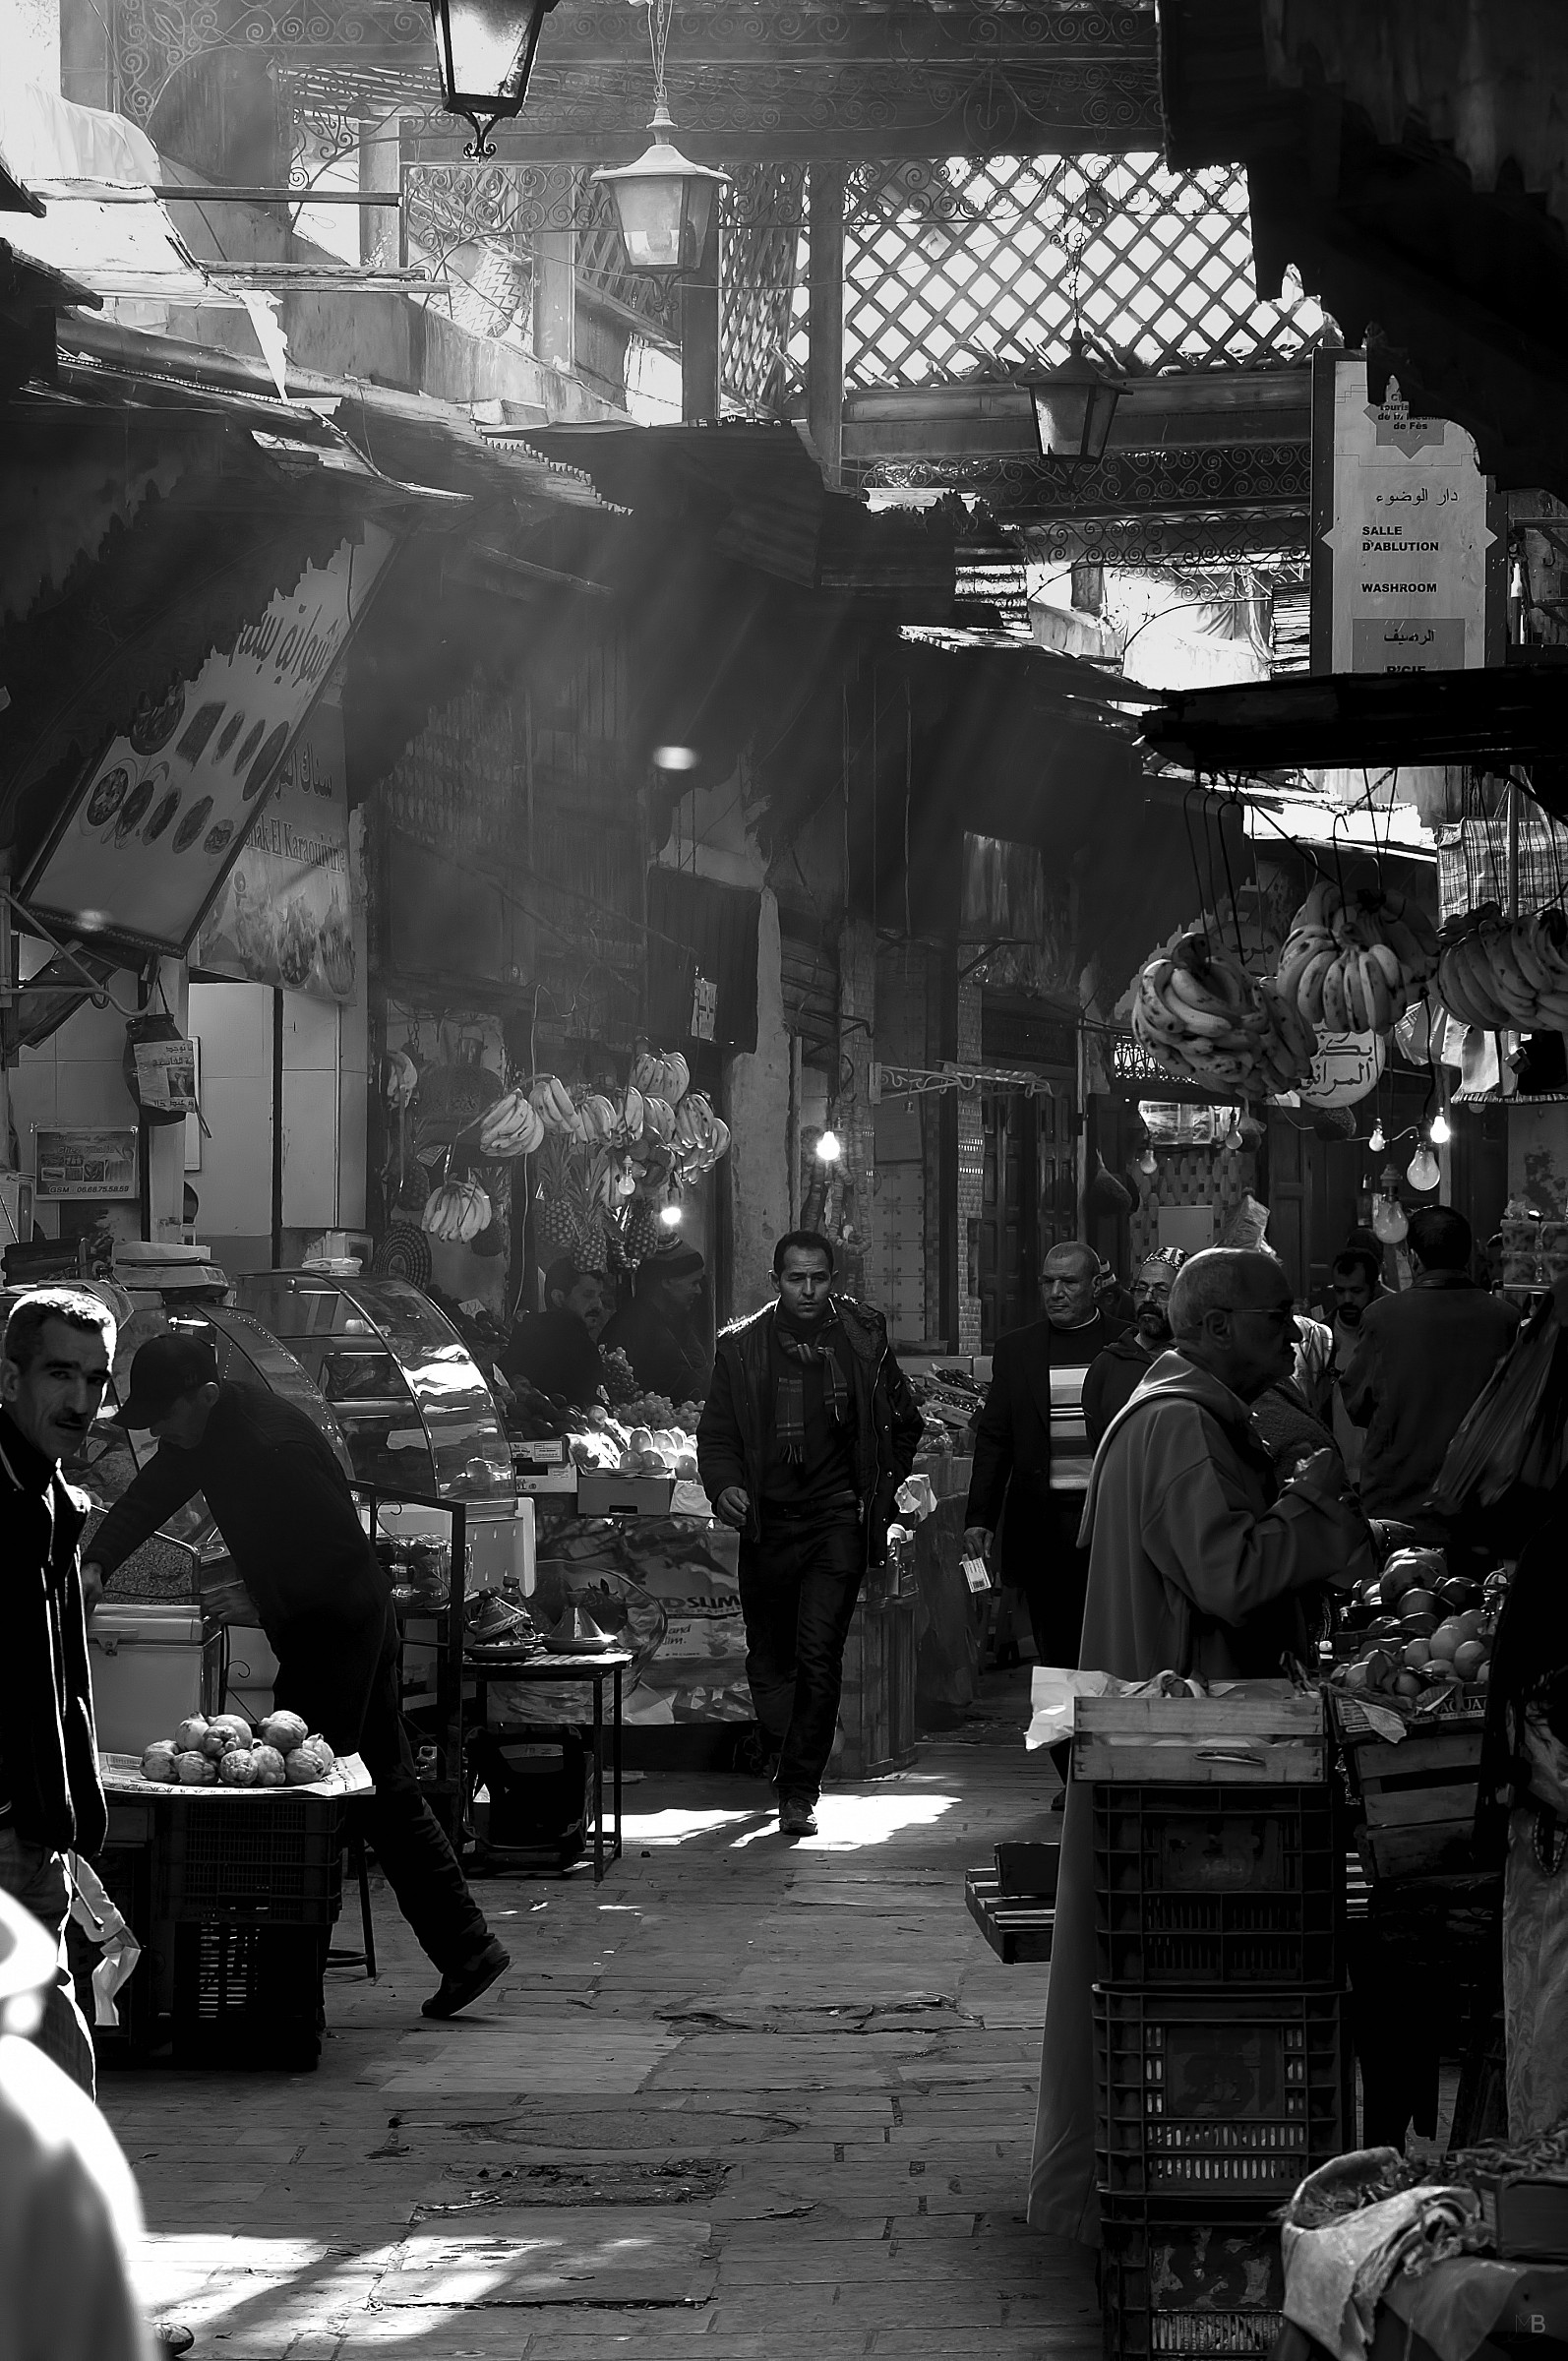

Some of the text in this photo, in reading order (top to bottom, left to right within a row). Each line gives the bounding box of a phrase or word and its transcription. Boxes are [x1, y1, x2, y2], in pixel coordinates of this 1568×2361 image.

[1393, 421, 1428, 431] de Fès
[1375, 487, 1459, 507] دار الوضوء
[1361, 525, 1403, 536] SALLE
[1361, 540, 1439, 552] D'ABLUTION
[1360, 582, 1437, 593] WASHROOM
